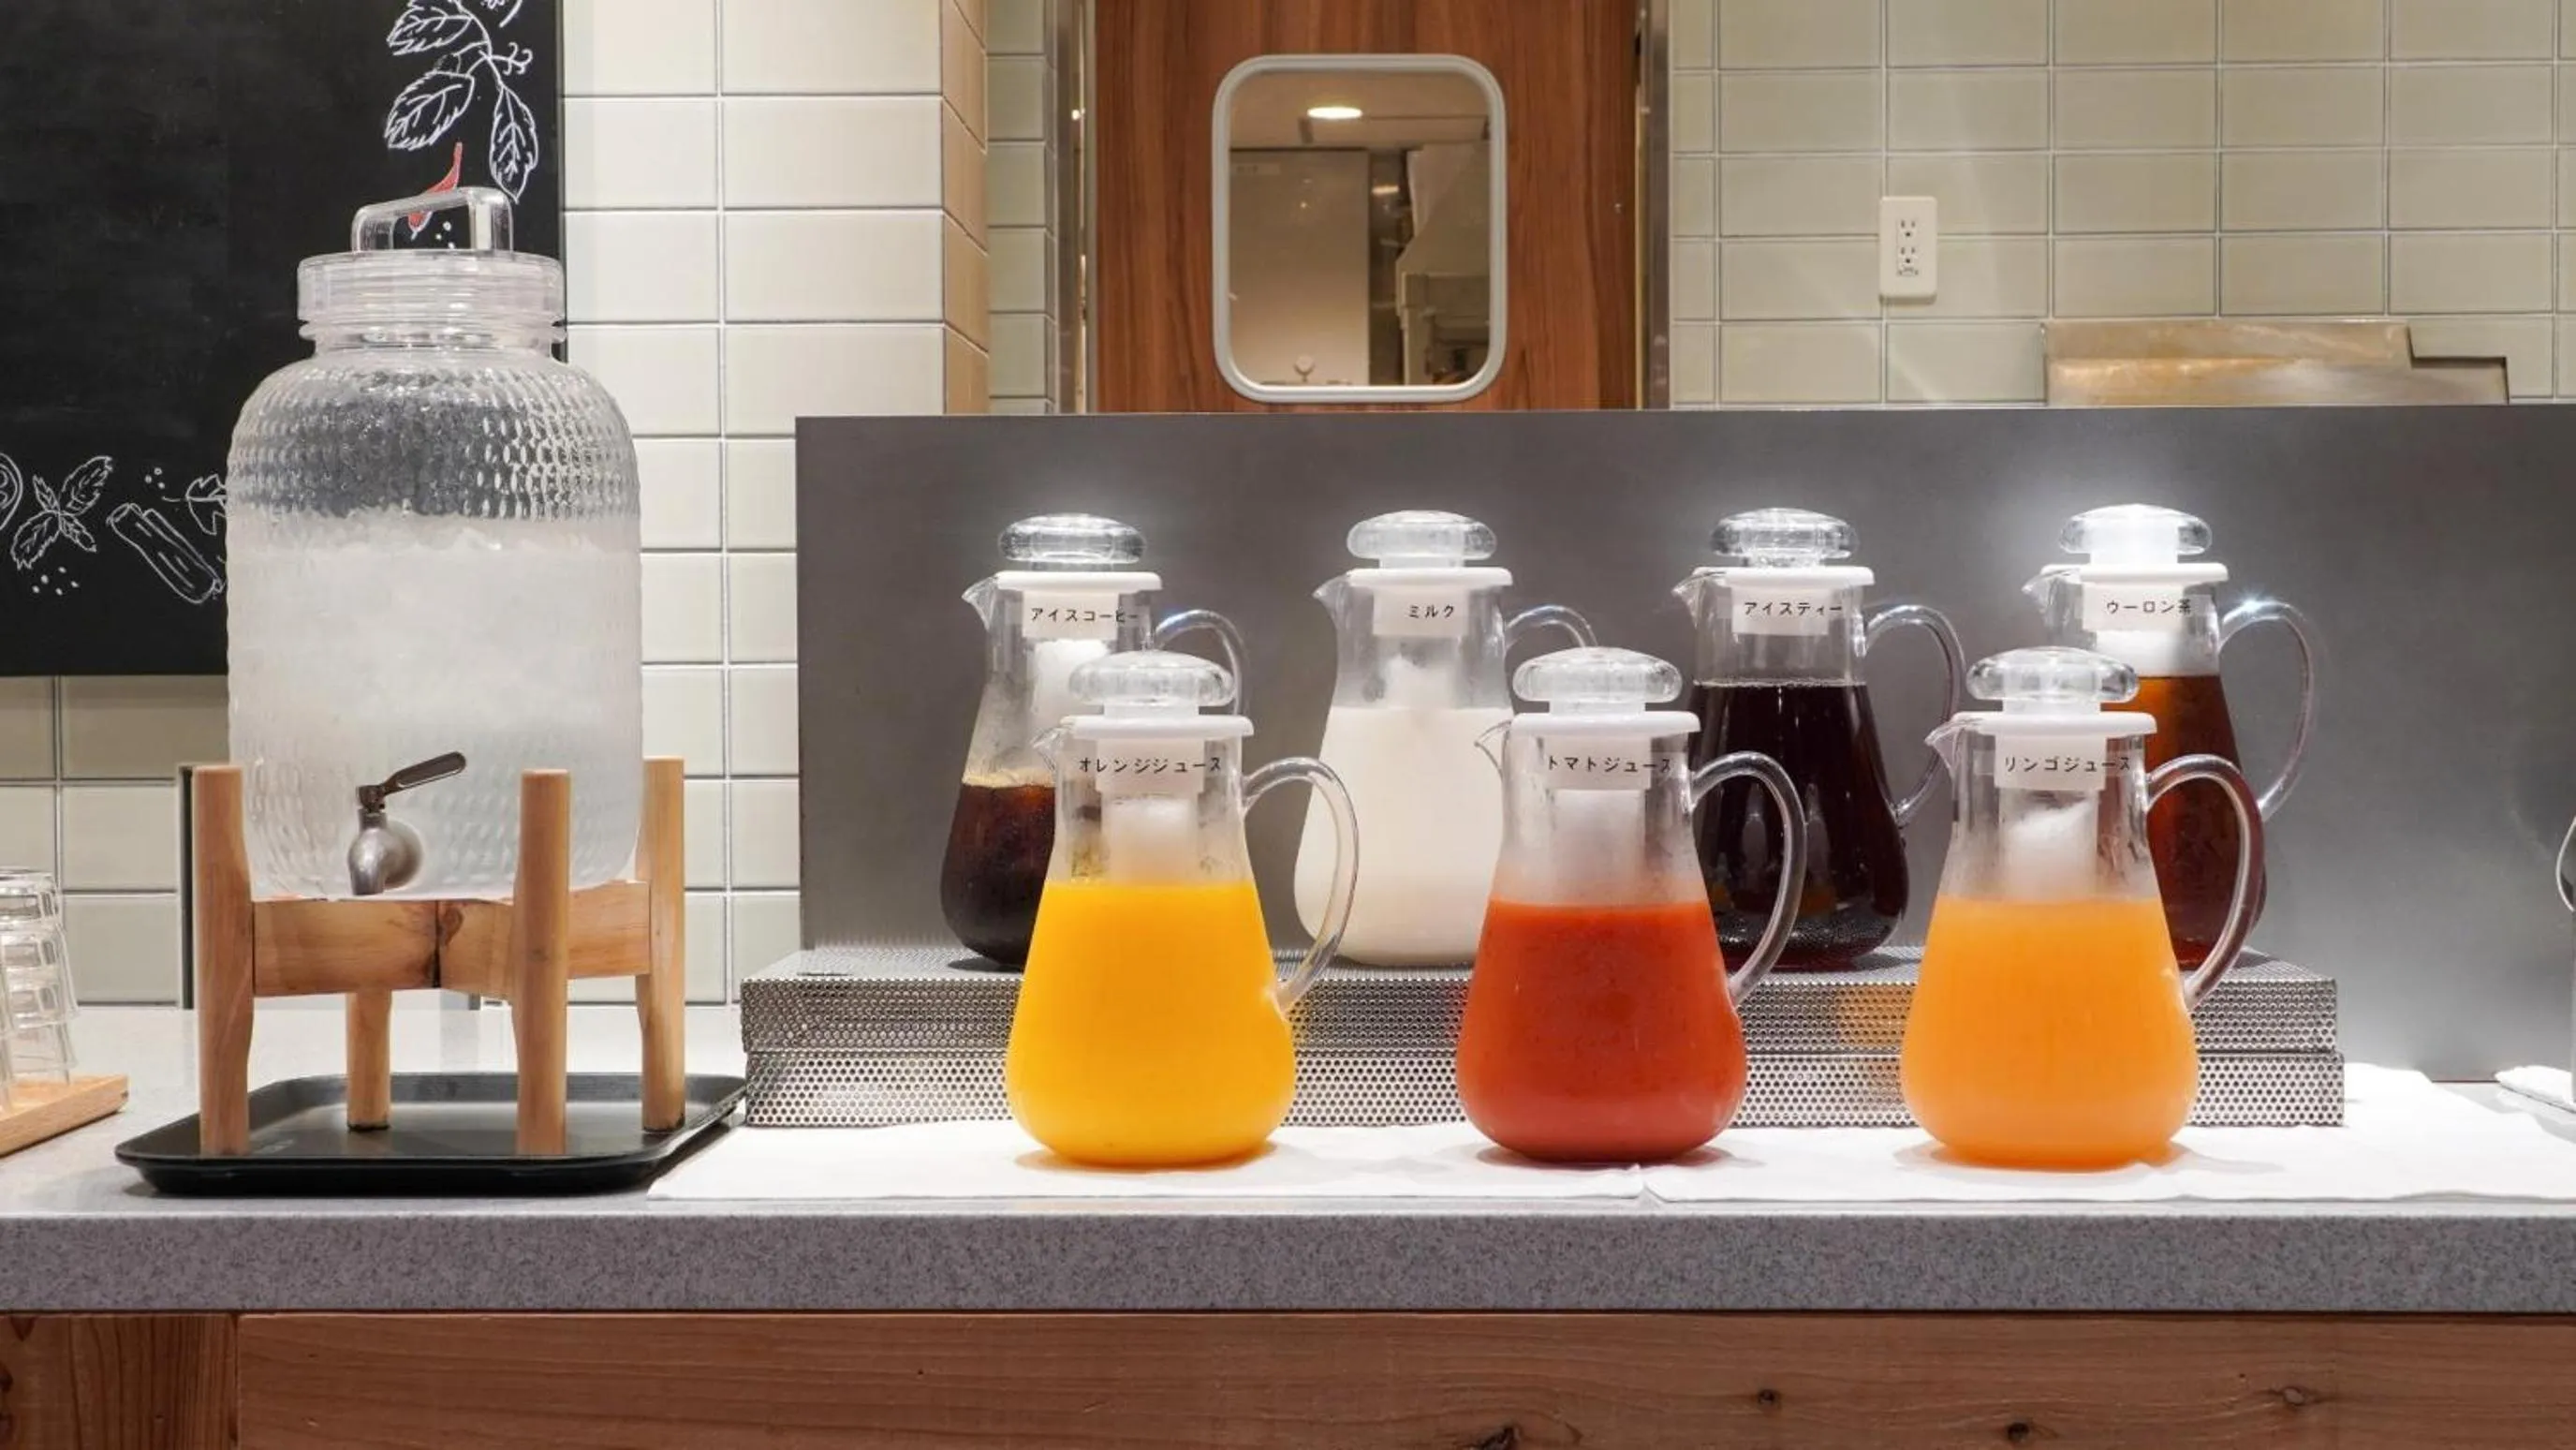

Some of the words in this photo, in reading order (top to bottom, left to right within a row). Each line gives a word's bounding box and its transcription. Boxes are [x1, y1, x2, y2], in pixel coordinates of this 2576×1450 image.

[1031, 607, 1140, 623] アイスコーヒー
[1408, 604, 1454, 619] ミルク
[1744, 601, 1843, 616] アイスティー
[2106, 599, 2191, 615] ウーロン茶
[1079, 757, 1221, 775] オレンジジュース
[1548, 755, 1671, 773] トマトジュース
[2005, 756, 2130, 773] リンゴジュース
